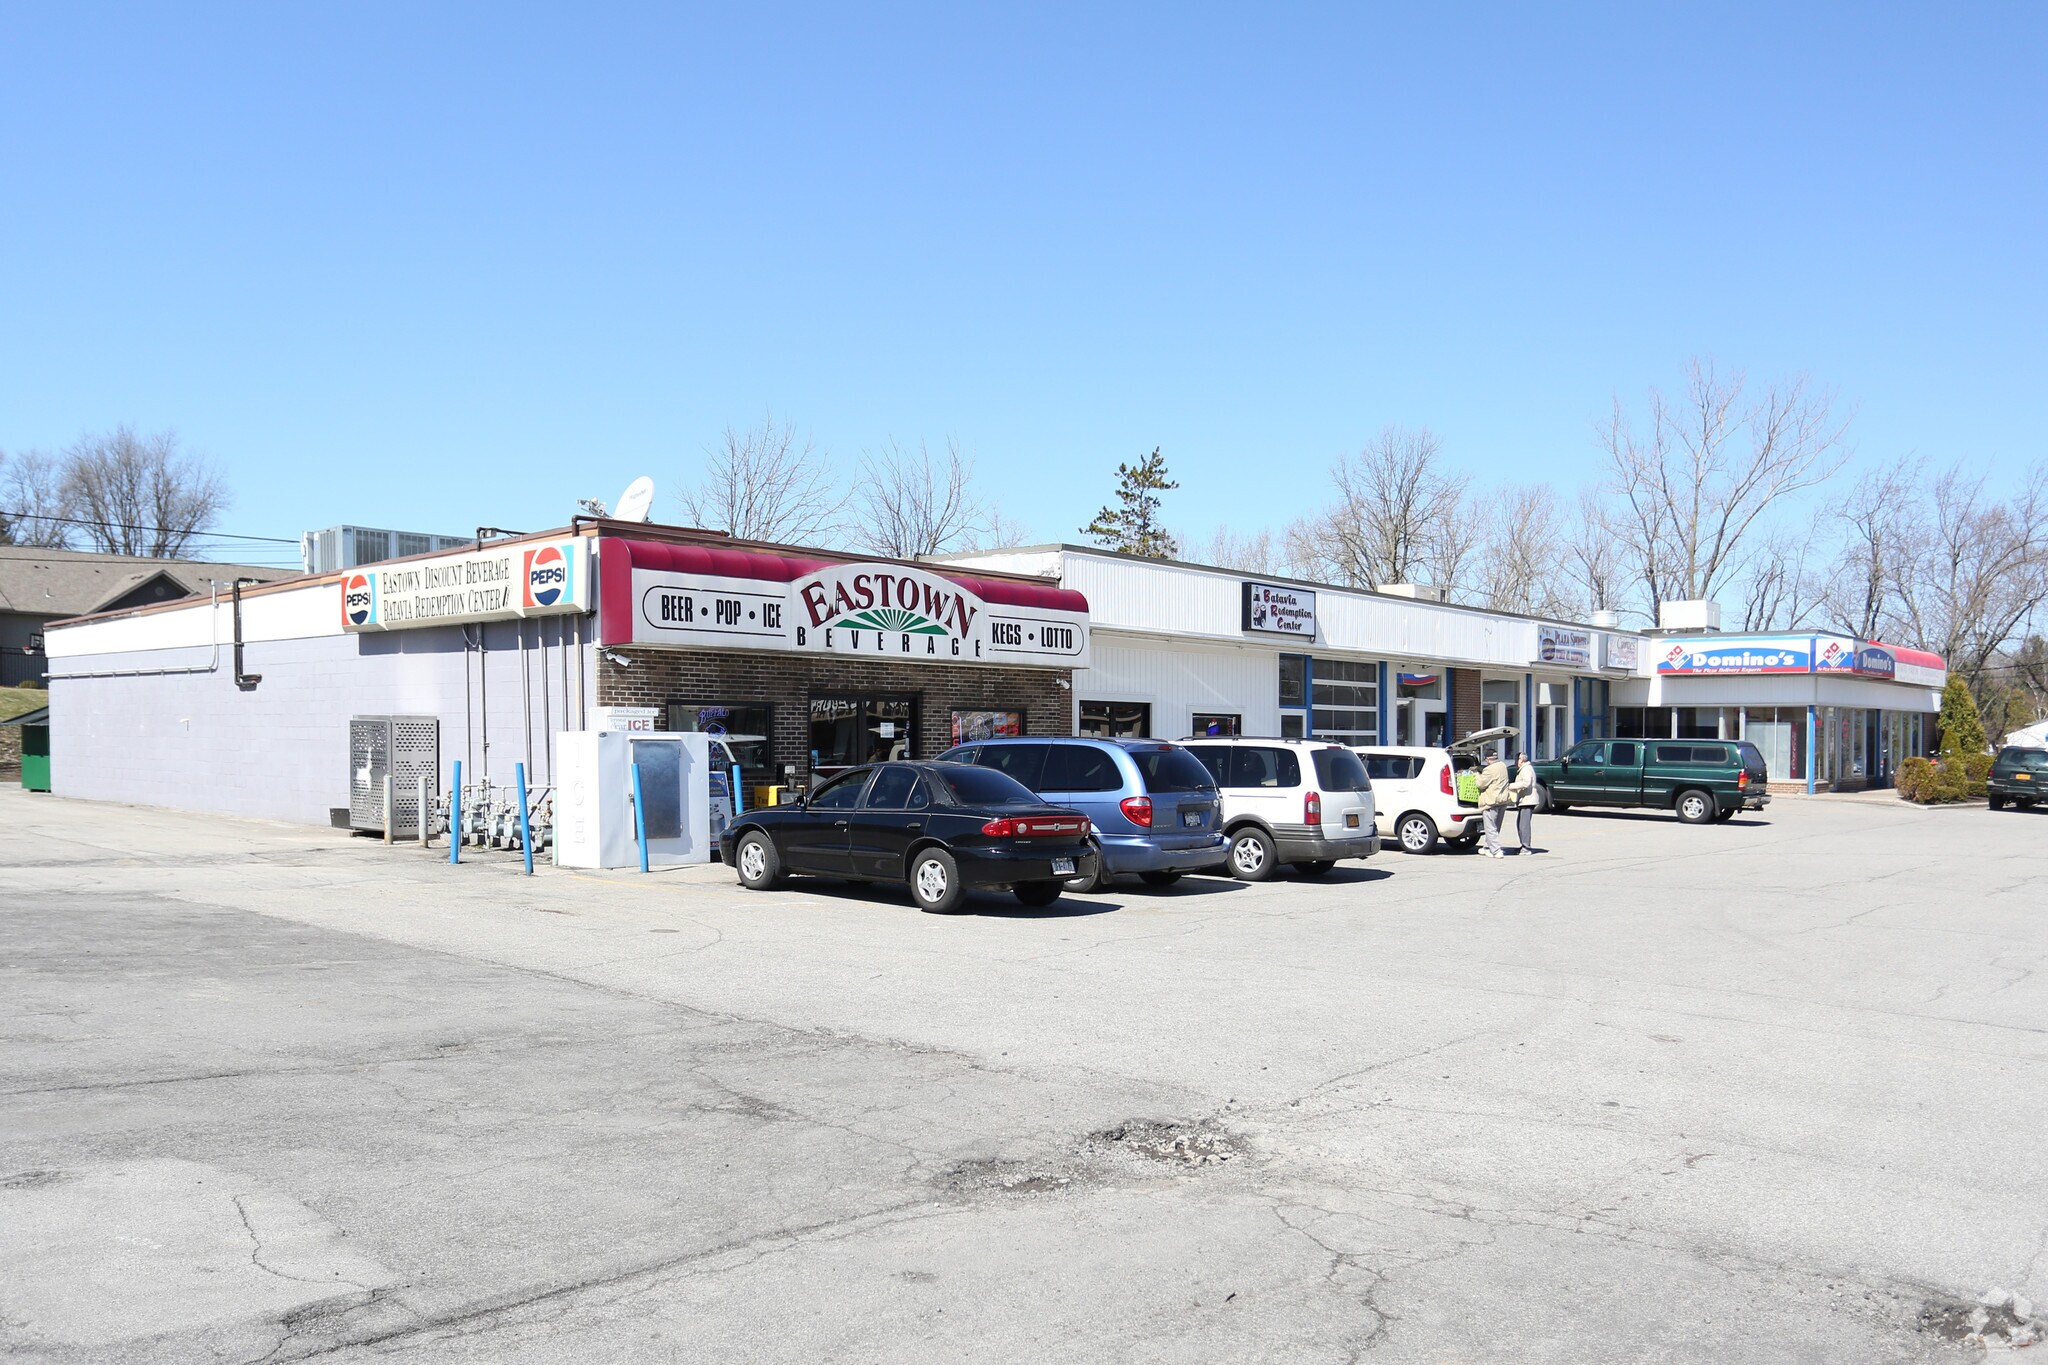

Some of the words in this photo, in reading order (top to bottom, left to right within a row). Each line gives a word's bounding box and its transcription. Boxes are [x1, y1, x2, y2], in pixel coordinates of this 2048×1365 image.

[382, 571, 421, 594] EASTOWN
[424, 564, 463, 589] DISCOUNT
[466, 557, 510, 585] BEVERAGE
[530, 567, 566, 586] PEPSI
[346, 592, 371, 607] PEPSI
[383, 600, 413, 621] BATAVIA
[415, 593, 466, 619] REDEMPTION
[468, 588, 501, 613] CENTER
[1263, 588, 1297, 606] Batavia
[661, 594, 694, 623] BEER
[715, 598, 742, 626] POP
[762, 602, 782, 629] ICE
[800, 574, 978, 640] EASTOWN
[1270, 604, 1313, 620] Redemption
[1276, 616, 1302, 632] Center
[797, 625, 981, 657] BEVERAGE
[992, 622, 1022, 646] KEGS
[1041, 626, 1073, 649] LOTTO
[1692, 651, 1795, 667] Domino's
[1862, 652, 1892, 671] Domino's
[628, 719, 651, 731] ICE
